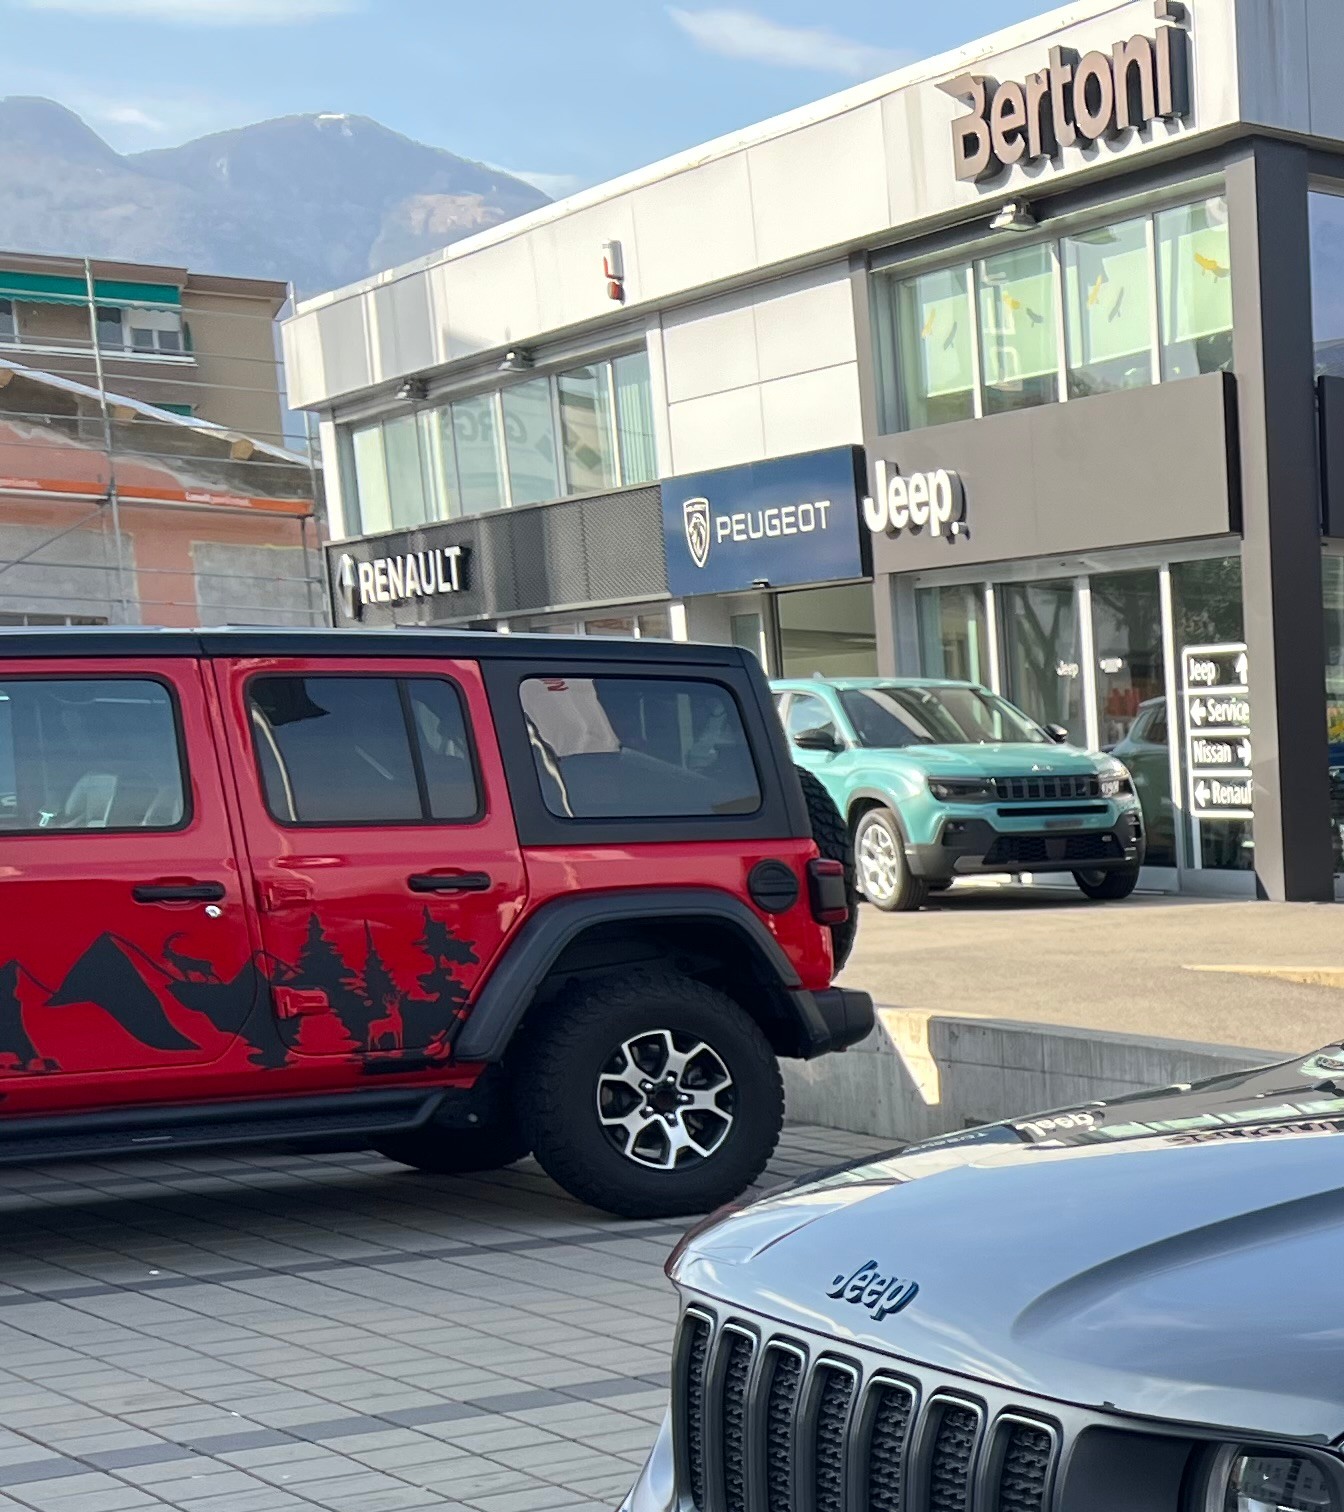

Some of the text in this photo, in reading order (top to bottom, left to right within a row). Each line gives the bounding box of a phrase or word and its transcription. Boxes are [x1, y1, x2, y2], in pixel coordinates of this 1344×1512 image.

[935, 0, 1190, 182] Bertoni
[716, 500, 831, 544] PEUGEOT
[863, 459, 954, 537] Jeep
[358, 546, 462, 604] RENAULT
[1189, 658, 1216, 687] Jeep
[1207, 697, 1250, 723] Service
[1193, 739, 1232, 764] Nissan
[826, 1259, 920, 1321] Jeep
